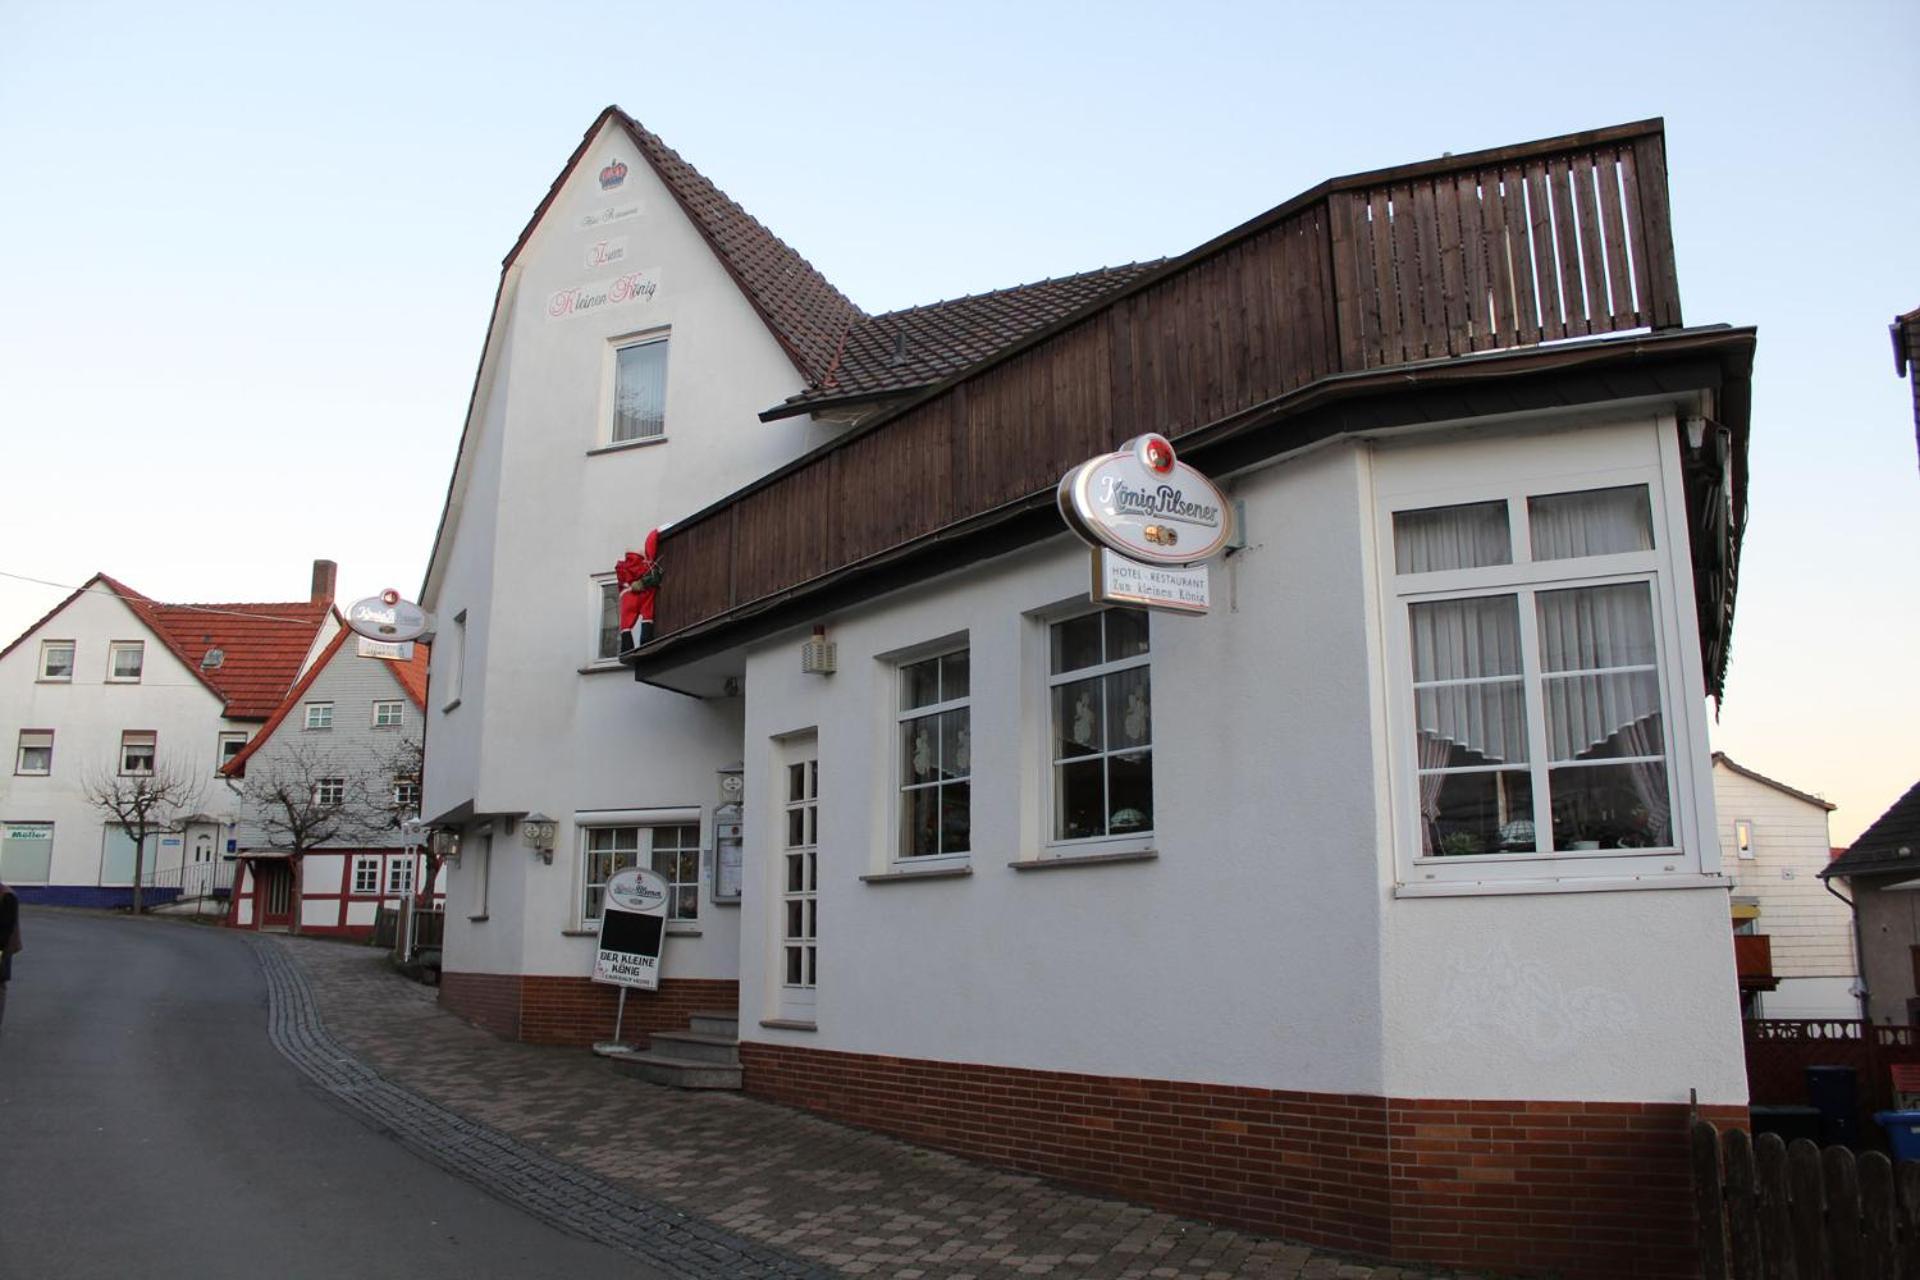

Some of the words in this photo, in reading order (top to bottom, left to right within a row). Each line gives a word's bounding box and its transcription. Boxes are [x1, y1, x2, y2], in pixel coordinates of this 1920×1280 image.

[549, 287, 607, 317] Kleinen
[1112, 567, 1141, 580] HOTEL
[1150, 572, 1204, 589] RESTAURANT
[600, 951, 619, 963] DER
[621, 953, 655, 967] KLEINE
[611, 963, 641, 976] KÖNIG
